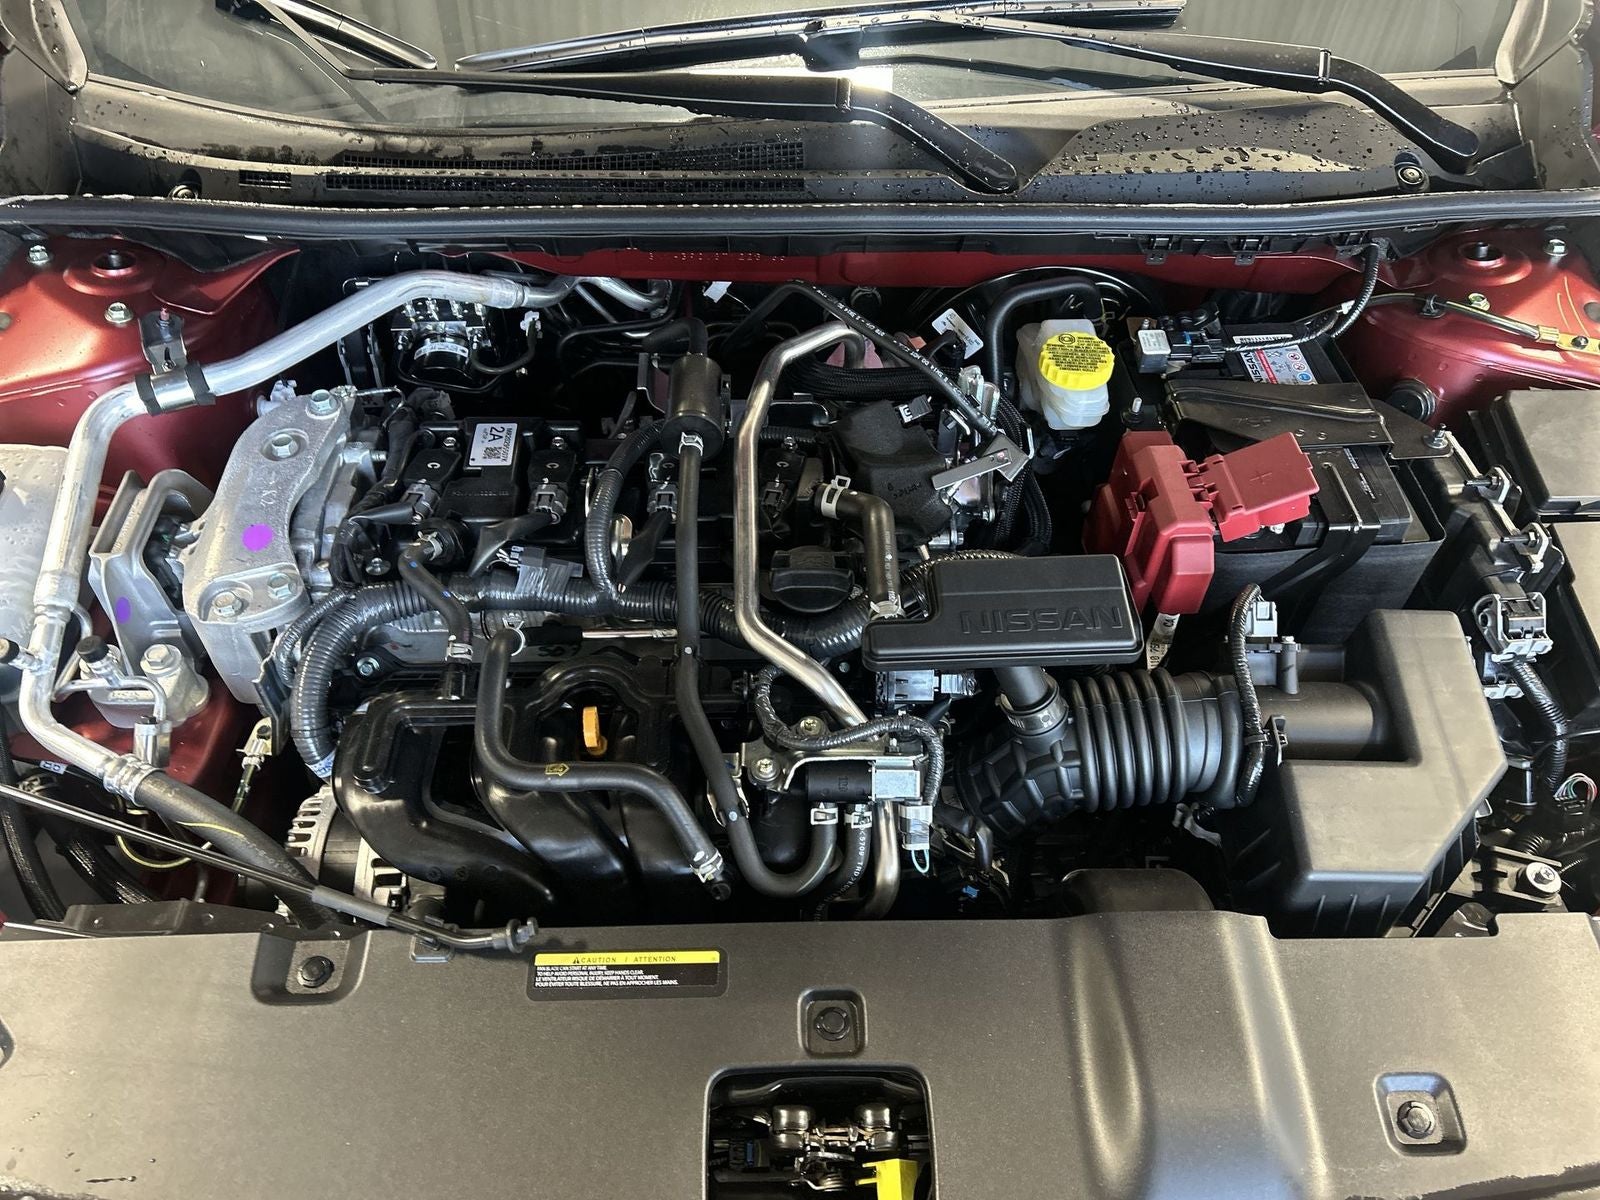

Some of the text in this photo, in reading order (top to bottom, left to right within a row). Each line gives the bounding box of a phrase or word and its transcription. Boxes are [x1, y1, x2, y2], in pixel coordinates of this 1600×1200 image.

[488, 426, 505, 442] 2A
[960, 607, 1123, 634] NISSAN
[581, 956, 617, 964] CAUTION
